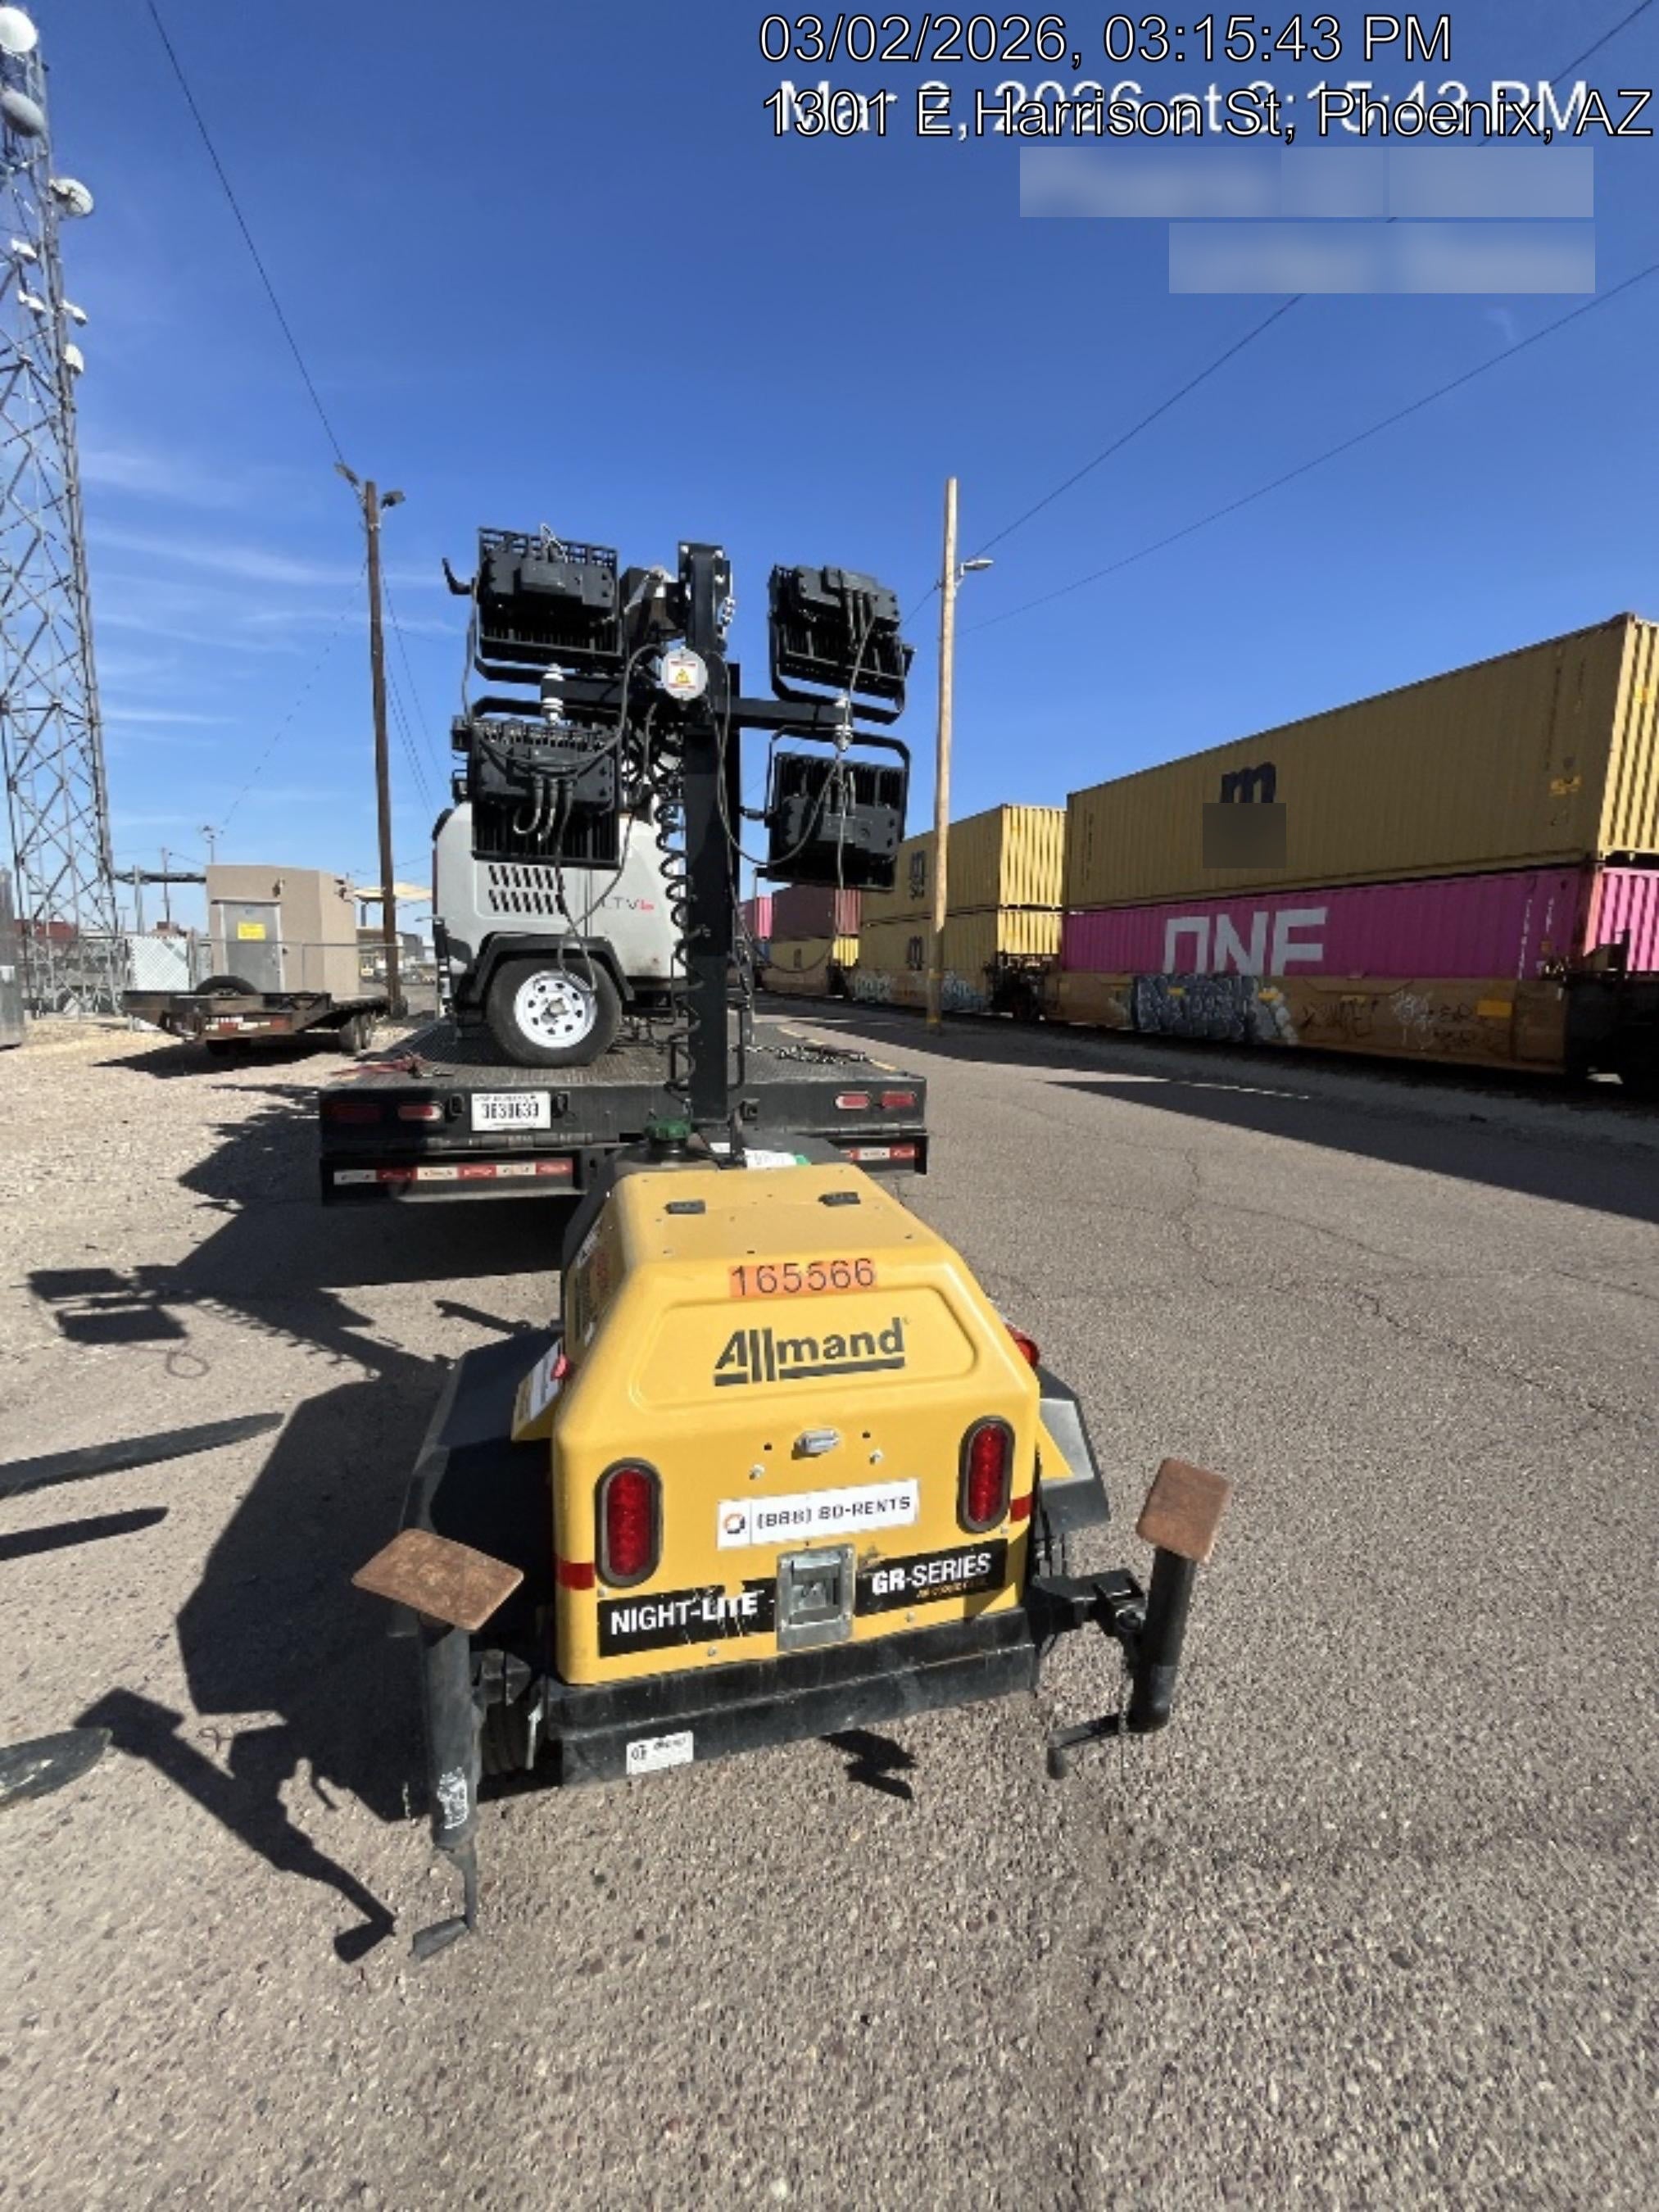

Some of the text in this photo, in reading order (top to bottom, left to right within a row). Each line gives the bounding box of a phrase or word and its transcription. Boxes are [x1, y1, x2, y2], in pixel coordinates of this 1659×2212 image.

[732, 1258, 874, 1296] 165566
[714, 1317, 904, 1382] Allmand
[872, 1552, 992, 1597] GR-SERIES
